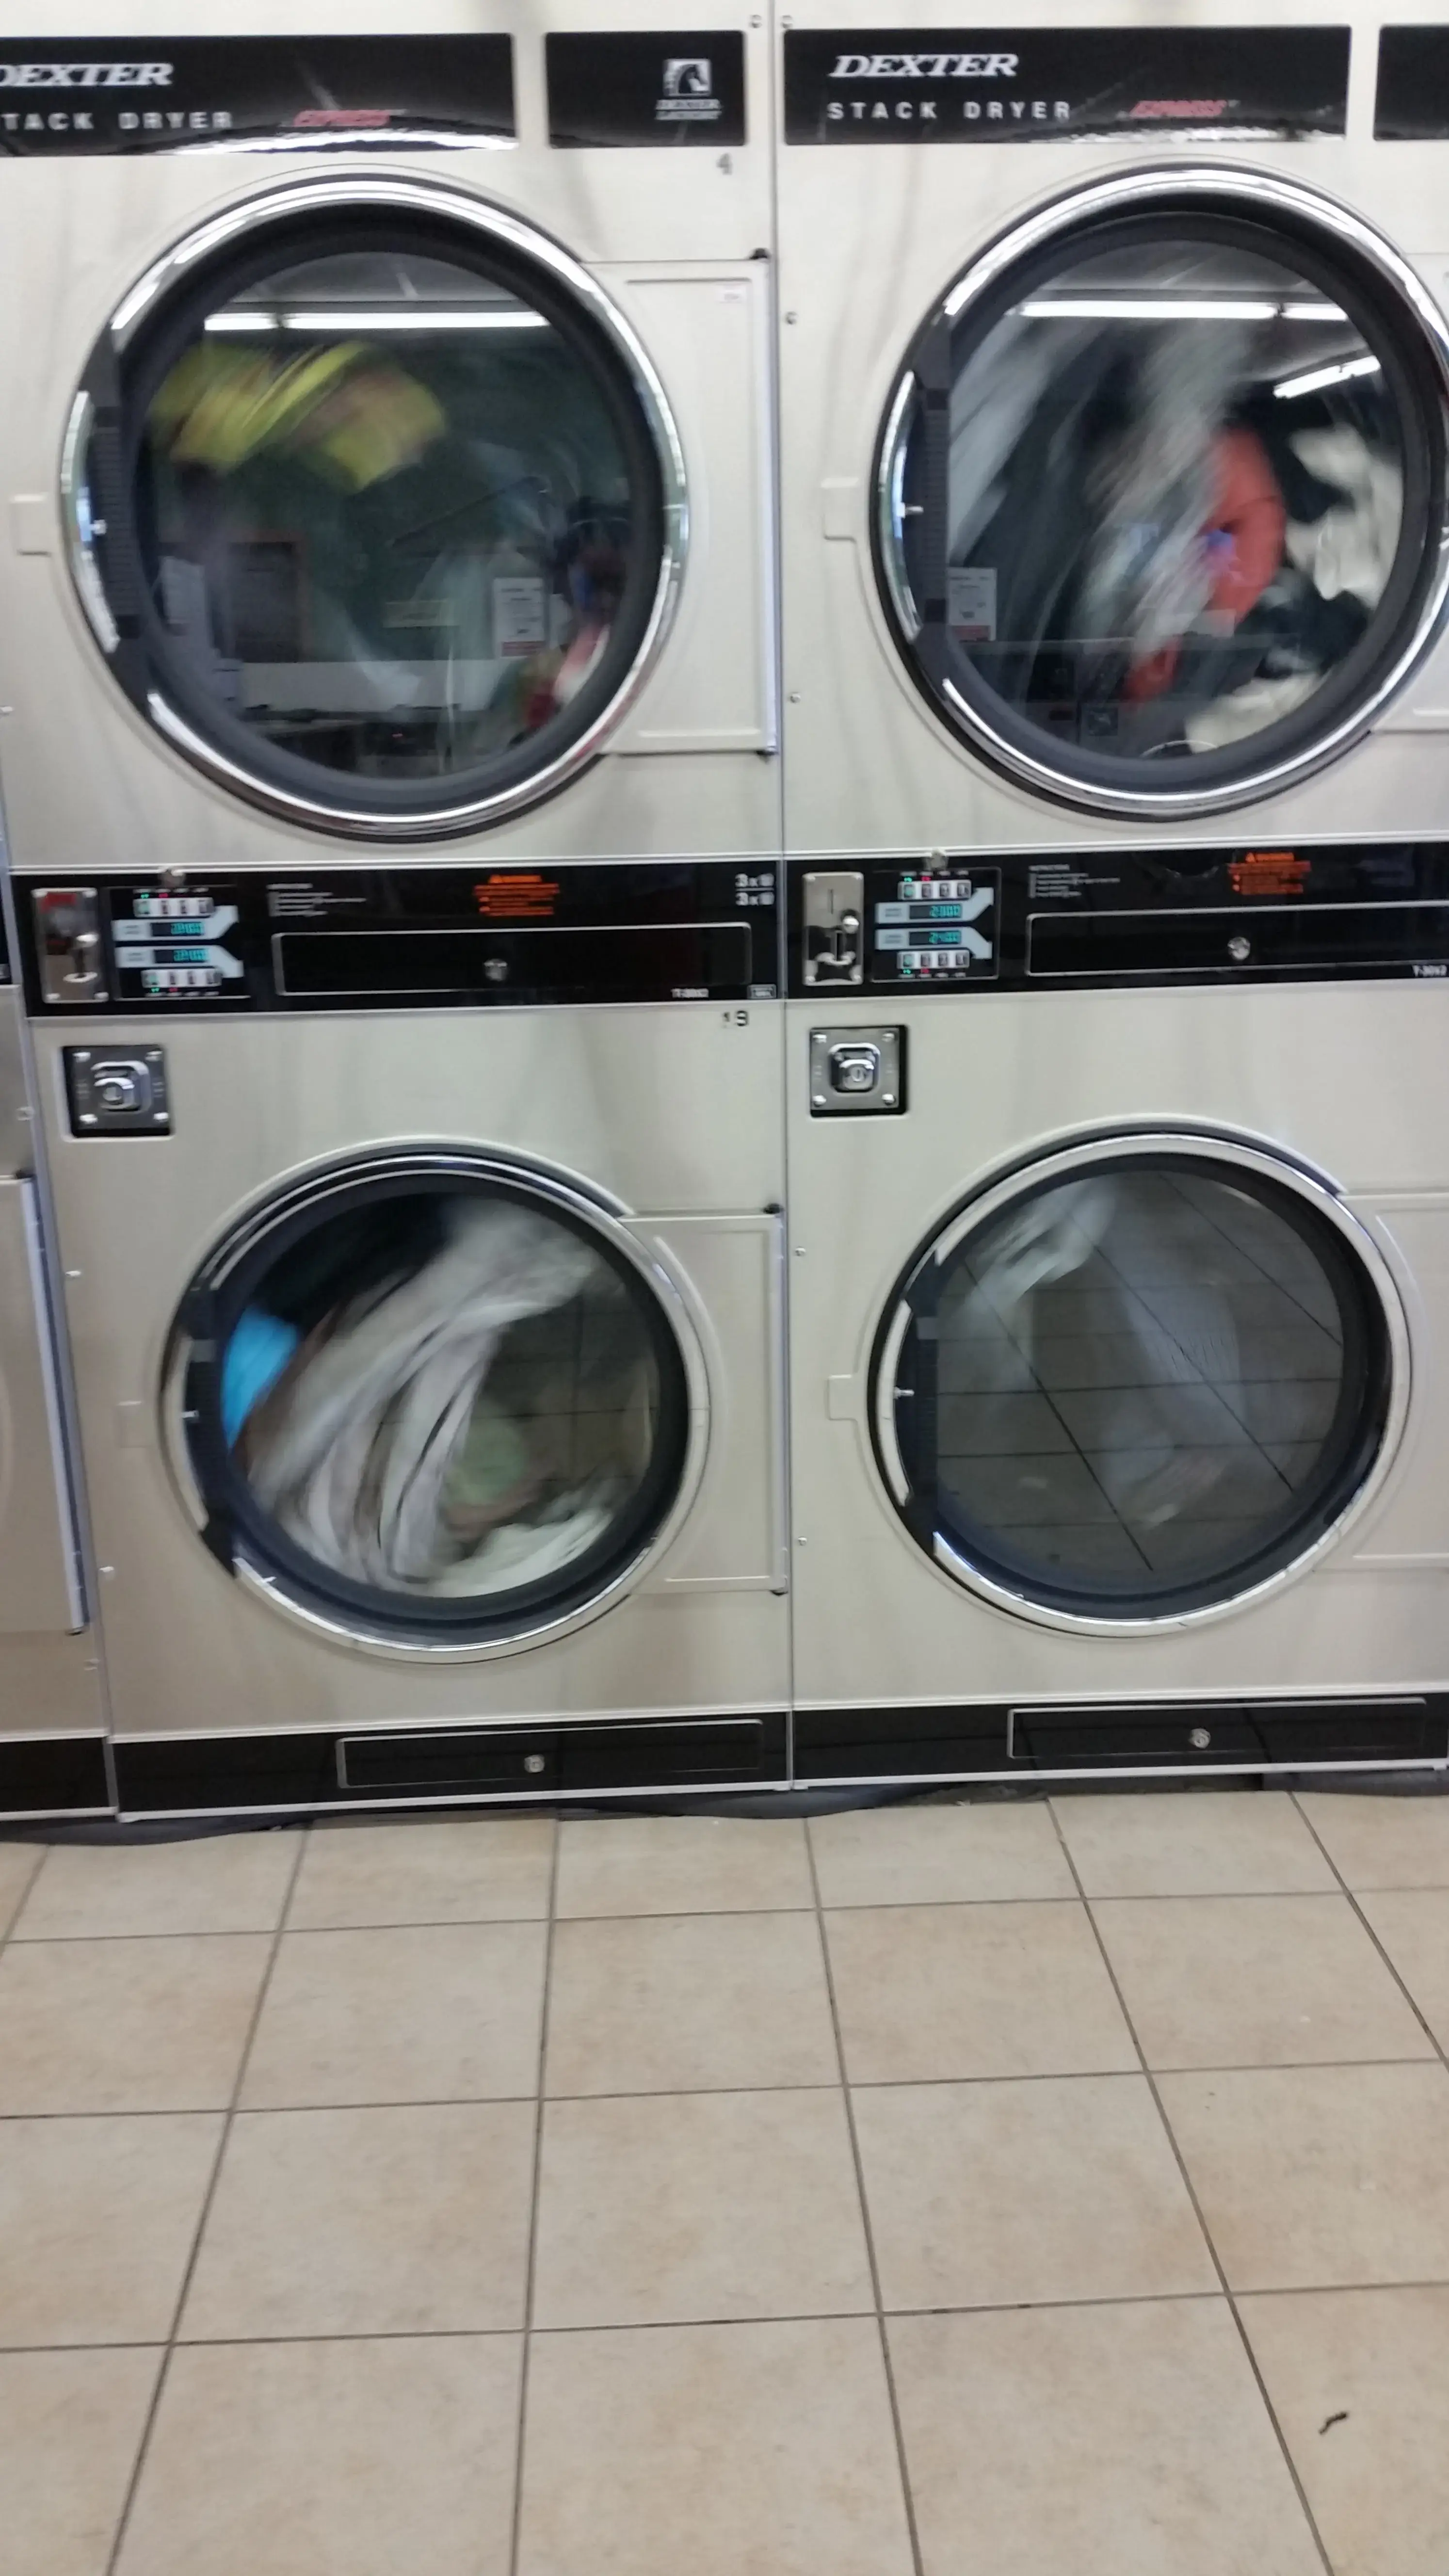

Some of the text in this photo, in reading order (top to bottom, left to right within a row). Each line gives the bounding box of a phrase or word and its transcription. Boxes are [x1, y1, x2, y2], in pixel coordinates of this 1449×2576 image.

[827, 53, 1020, 78] DEXTER
[826, 101, 1070, 120] STACK DRYER
[0, 112, 233, 130] TACK DRYER
